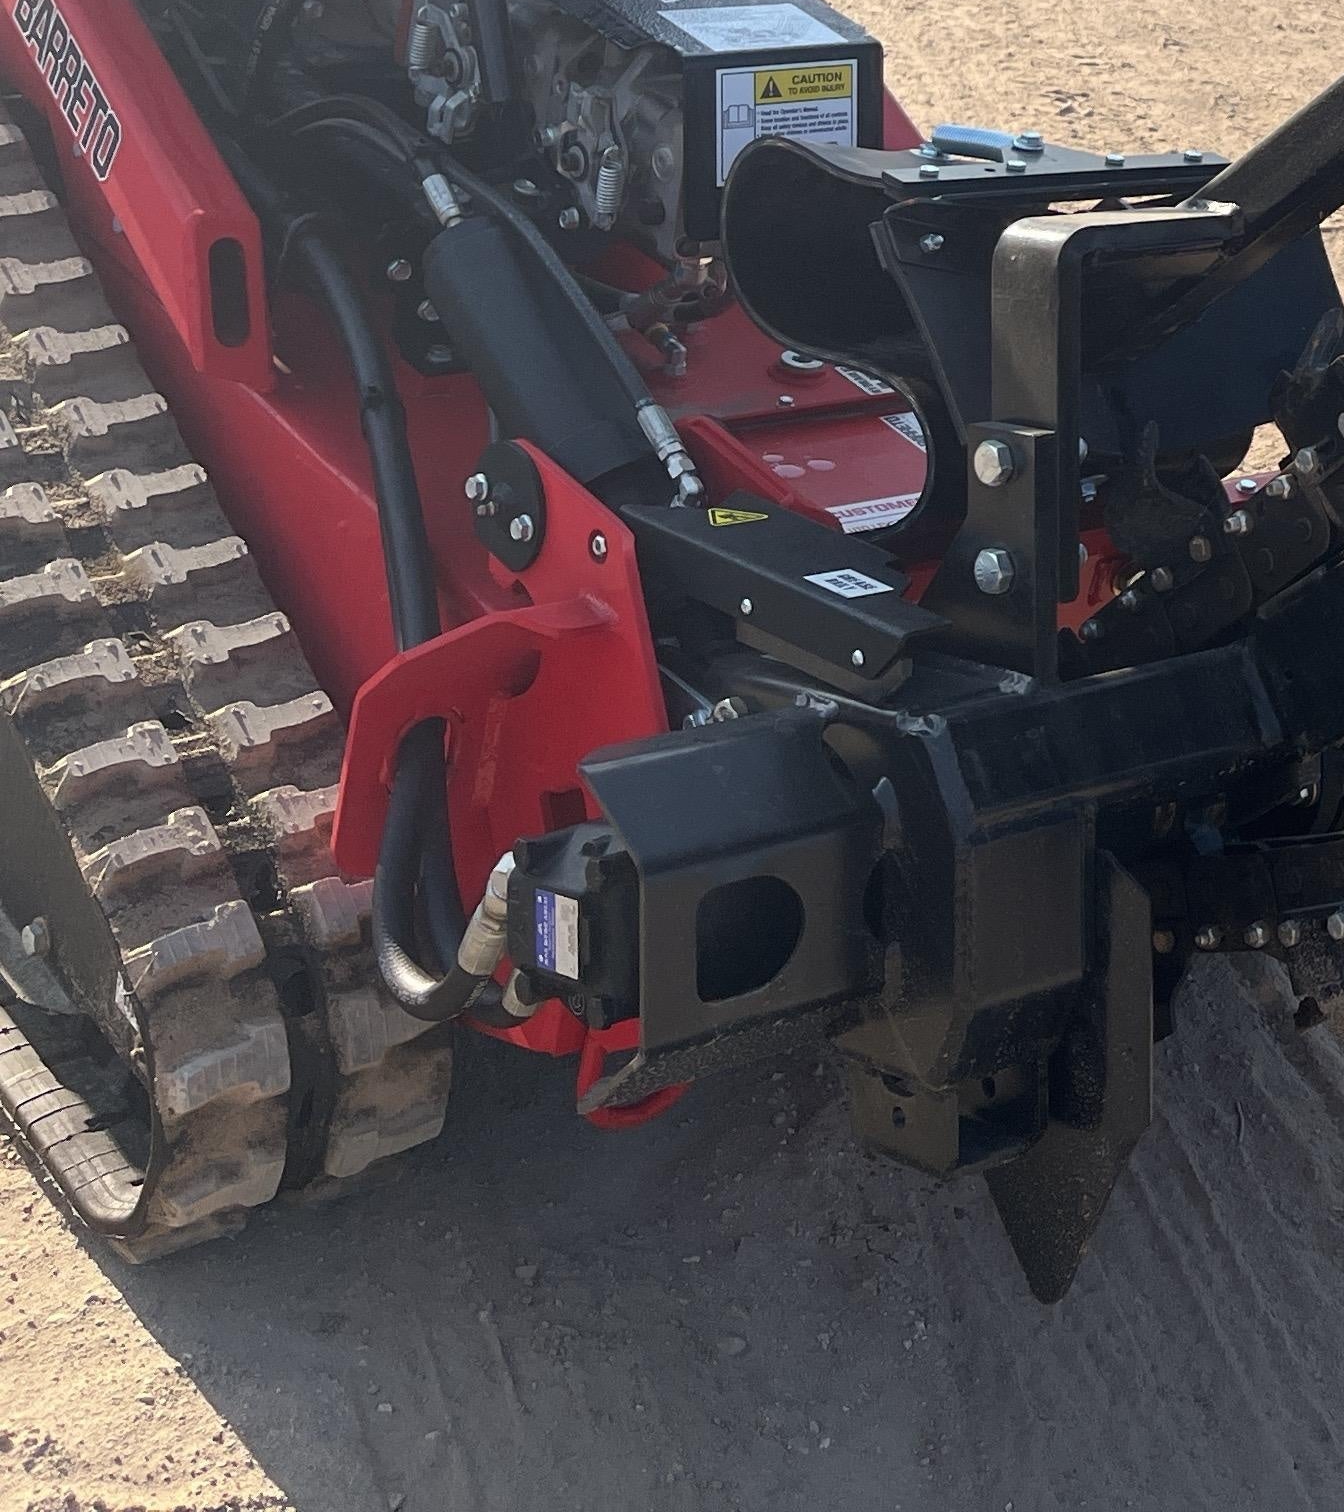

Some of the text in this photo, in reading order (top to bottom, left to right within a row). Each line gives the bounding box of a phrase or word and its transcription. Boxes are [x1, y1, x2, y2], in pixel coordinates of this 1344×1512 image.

[791, 72, 842, 85] CAUTION
[788, 87, 798, 95] TO
[799, 85, 820, 94] AVOID
